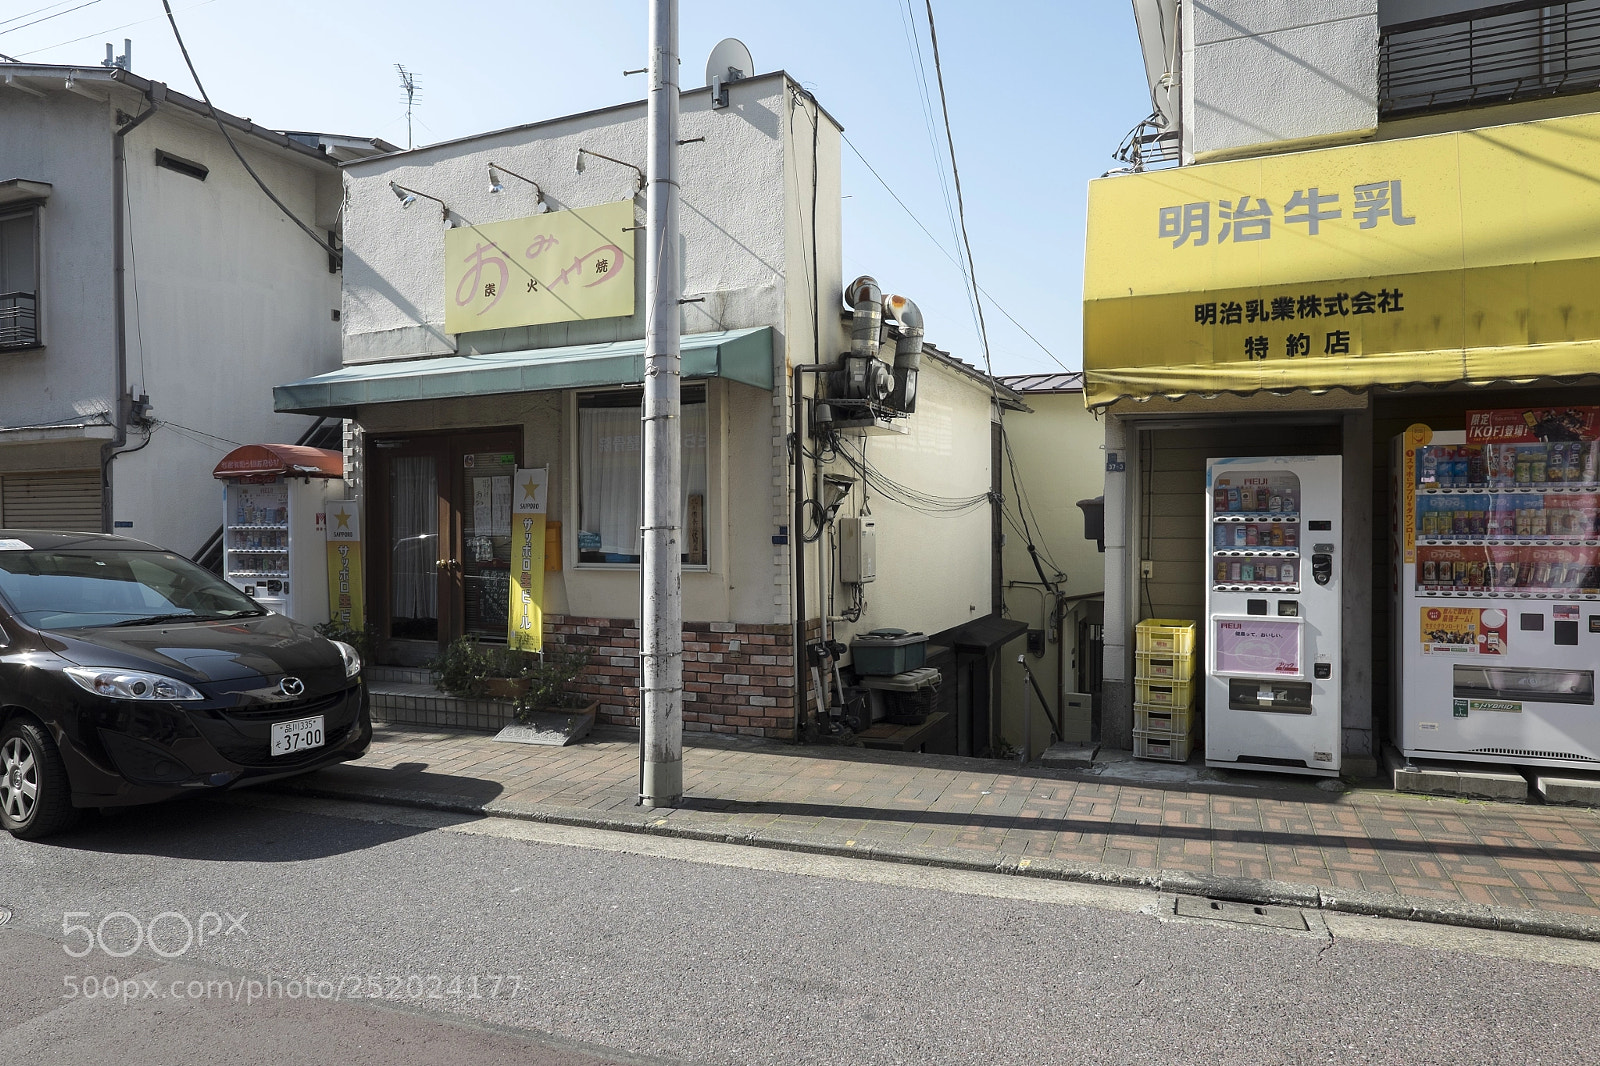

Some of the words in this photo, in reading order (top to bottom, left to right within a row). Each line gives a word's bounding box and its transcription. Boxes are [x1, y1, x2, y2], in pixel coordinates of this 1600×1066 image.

[1158, 180, 1416, 249] 明治牛乳
[1194, 288, 1404, 326] 明治乳業株式会社
[1245, 330, 1350, 360] 特約店
[1470, 413, 1490, 426] 限定
[519, 518, 534, 630] サッポロ生ビール
[1478, 702, 1514, 710] HYBRID
[284, 723, 299, 734] 品川
[300, 720, 313, 731] 335
[284, 729, 321, 751] 37-00
